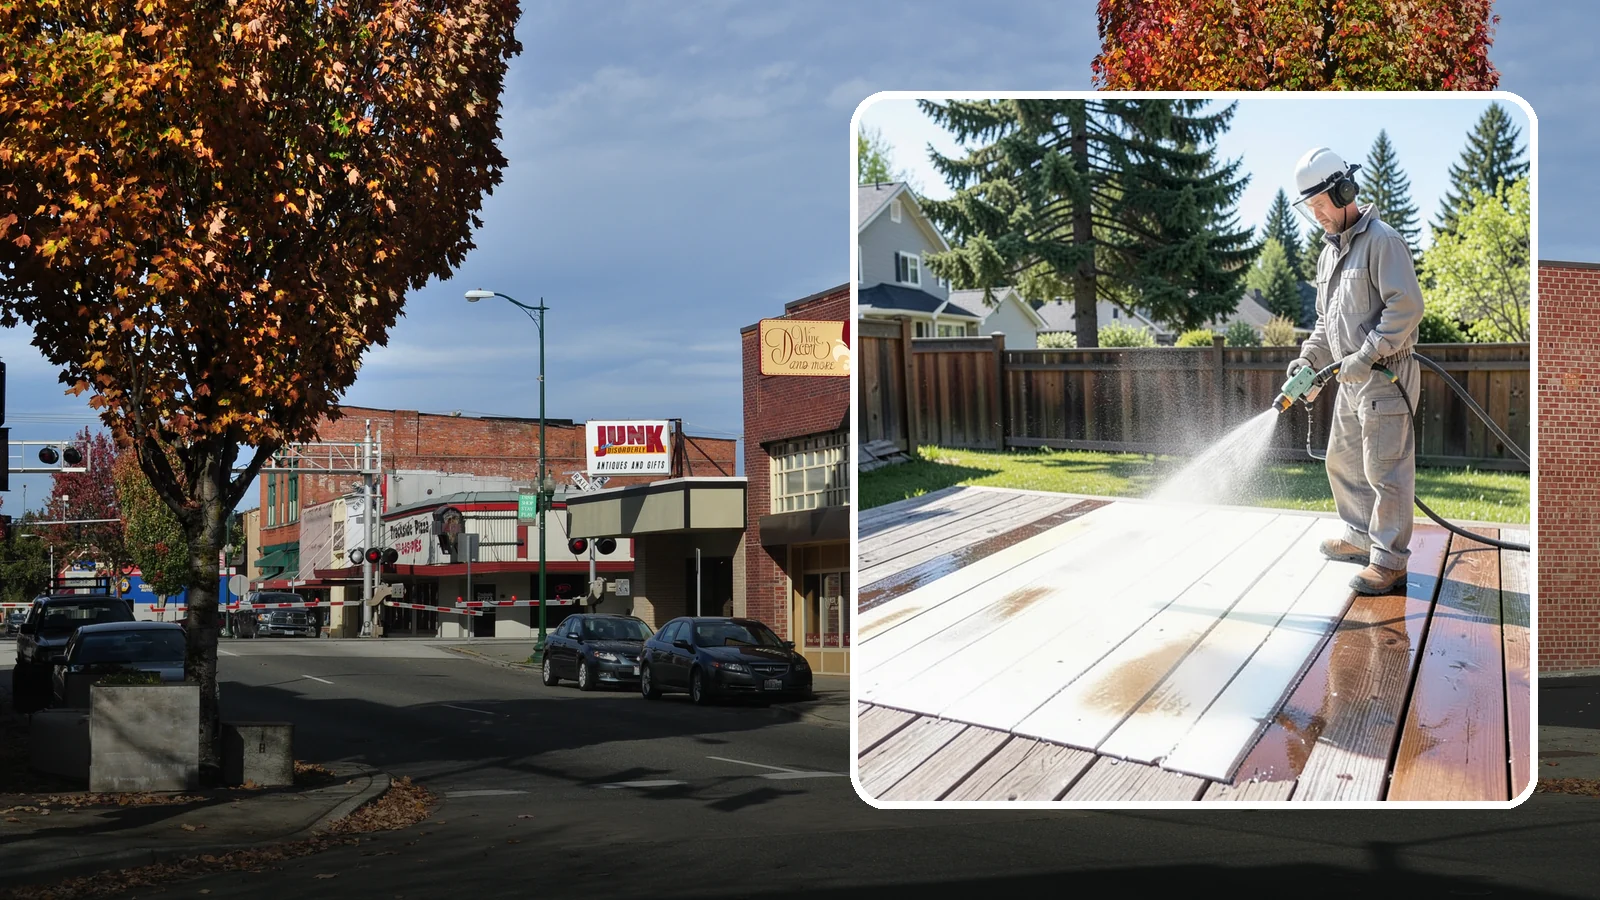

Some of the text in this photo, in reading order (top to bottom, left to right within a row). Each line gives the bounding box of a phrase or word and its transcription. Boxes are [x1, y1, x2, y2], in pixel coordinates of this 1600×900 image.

[596, 425, 665, 457] JUNK
[607, 446, 646, 454] DISORDERLY
[597, 460, 666, 470] ANTIQUES AND GIFTS
[390, 519, 429, 540] Trackside Pizza
